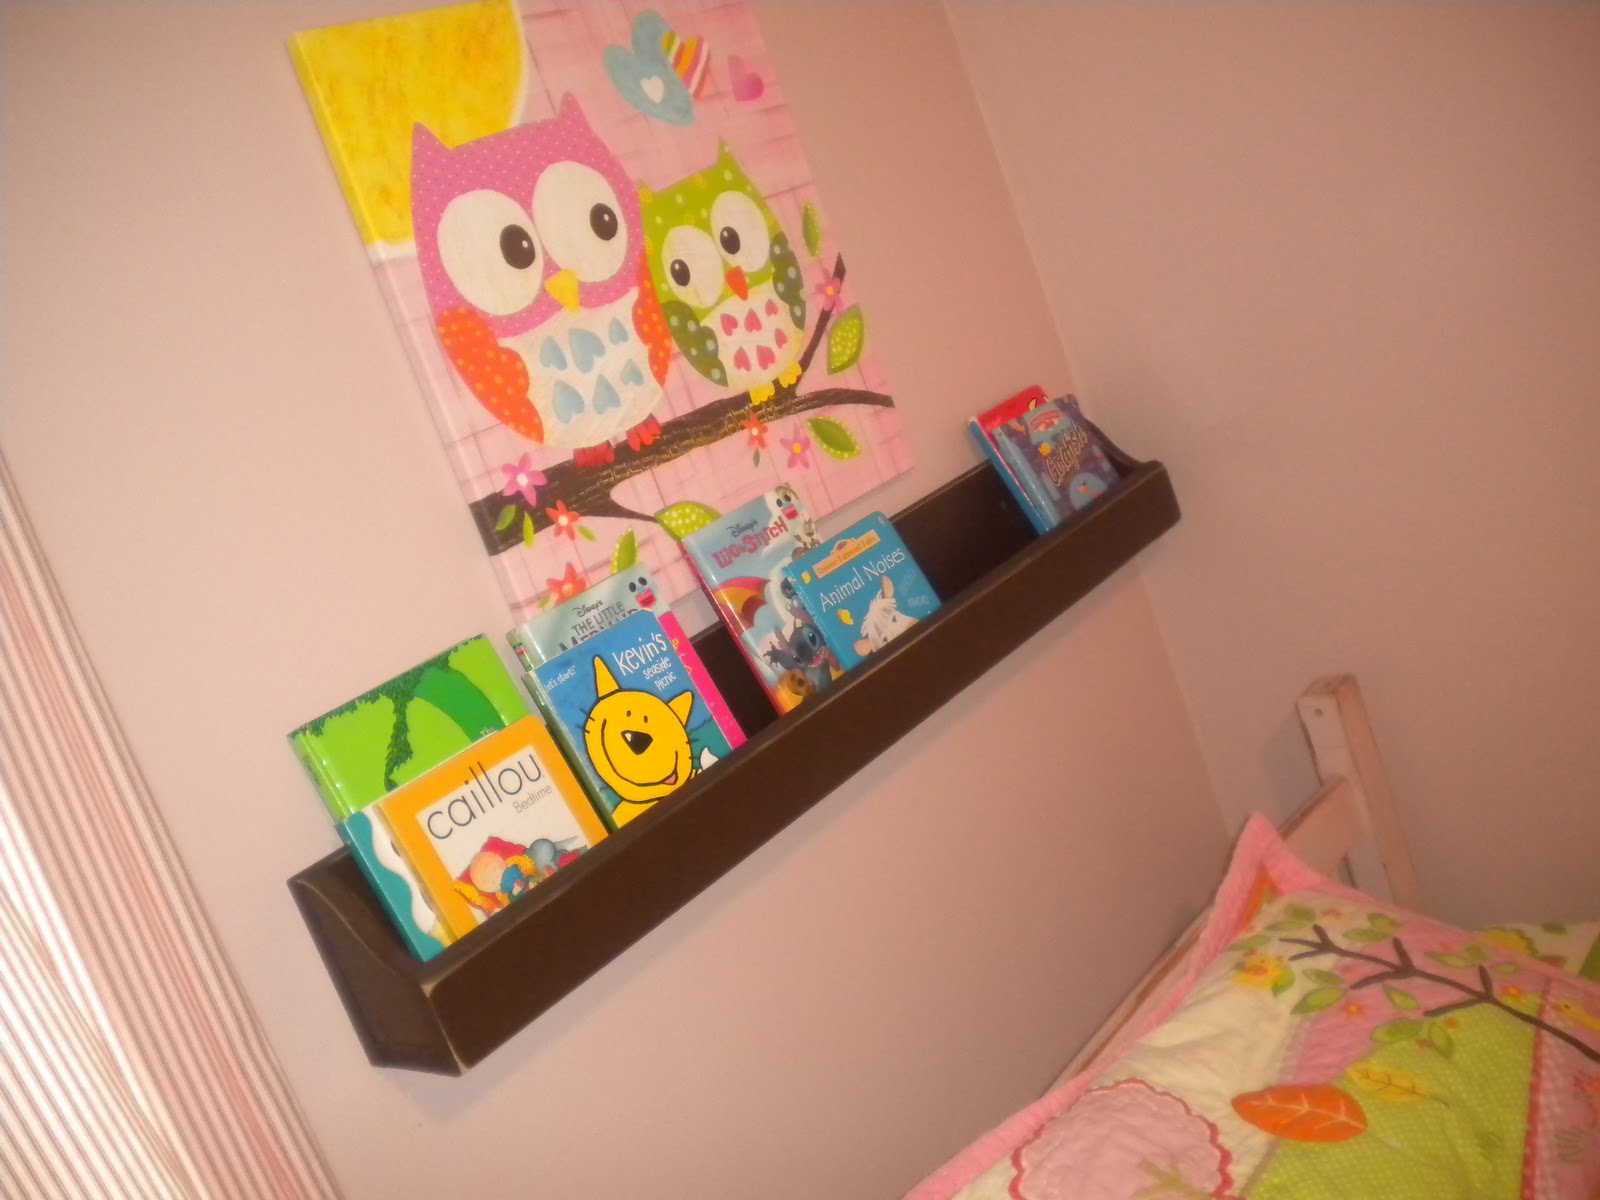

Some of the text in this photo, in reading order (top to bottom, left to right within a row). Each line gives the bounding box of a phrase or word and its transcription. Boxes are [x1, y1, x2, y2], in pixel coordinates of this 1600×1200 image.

[819, 548, 906, 613] Animal Noises
[572, 599, 604, 618] Disney's
[572, 618, 595, 637] THE
[595, 601, 626, 627] LITTLE
[642, 656, 672, 681] seaside
[427, 754, 542, 840] caillou
[512, 785, 553, 814] Bedtime
